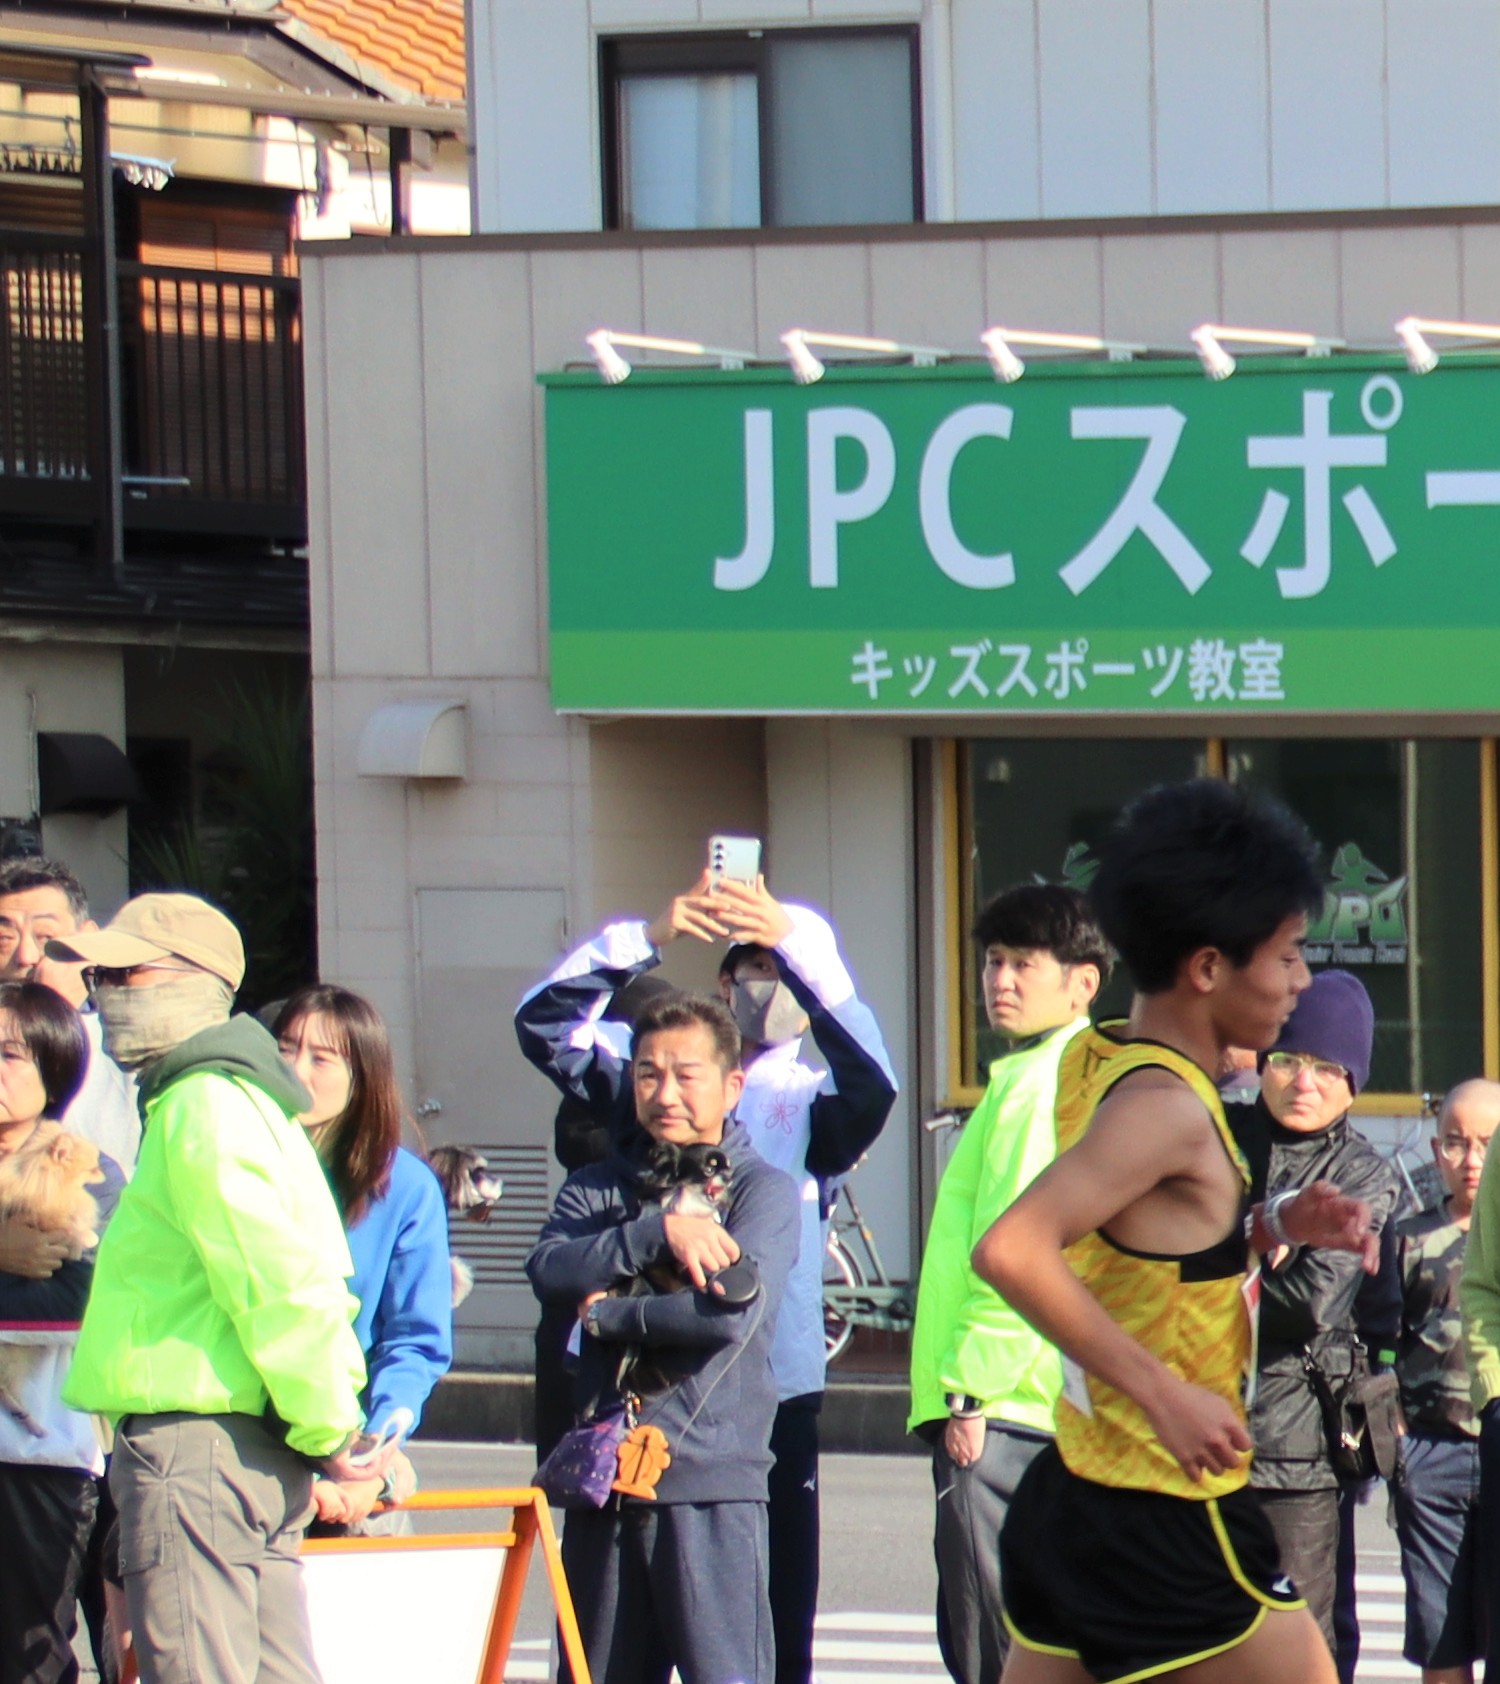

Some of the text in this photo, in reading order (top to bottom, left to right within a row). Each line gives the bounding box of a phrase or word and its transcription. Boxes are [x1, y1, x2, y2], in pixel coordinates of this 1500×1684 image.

[850, 637, 1286, 703] キッズスポーツ教室
